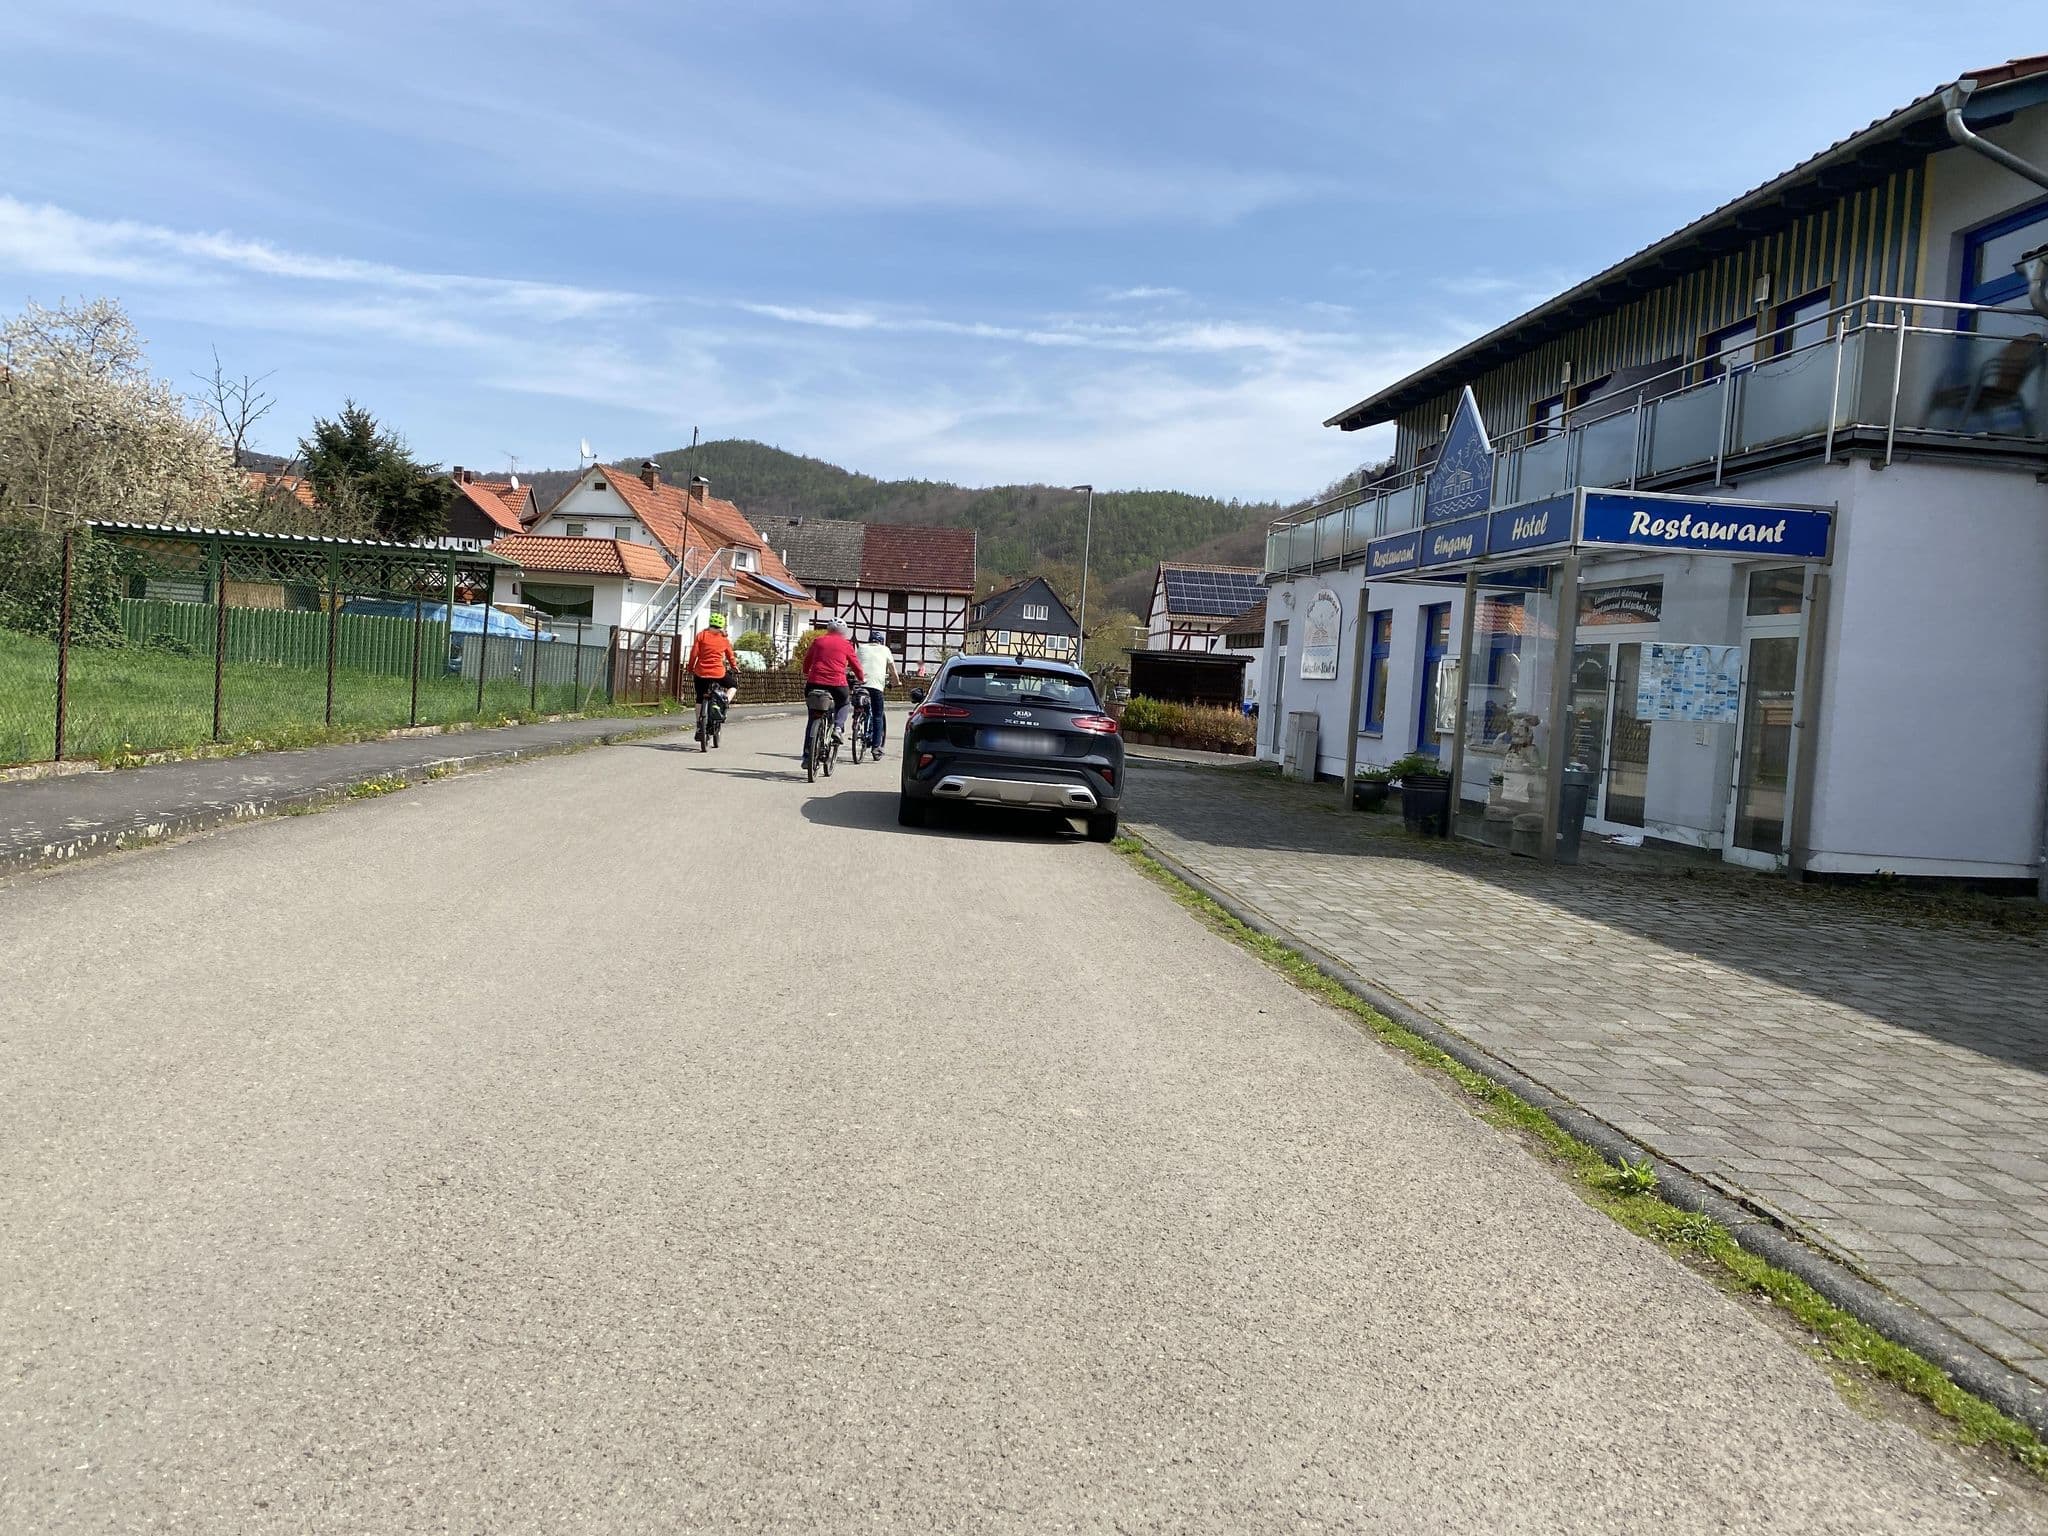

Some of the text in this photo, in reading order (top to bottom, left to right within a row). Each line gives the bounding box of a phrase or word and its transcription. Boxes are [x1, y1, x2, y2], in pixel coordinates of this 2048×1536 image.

[1373, 511, 1549, 568] Restaurant Eingang Hotel
[1629, 511, 1786, 543] Restaurant
[1013, 710, 1032, 719] KIA
